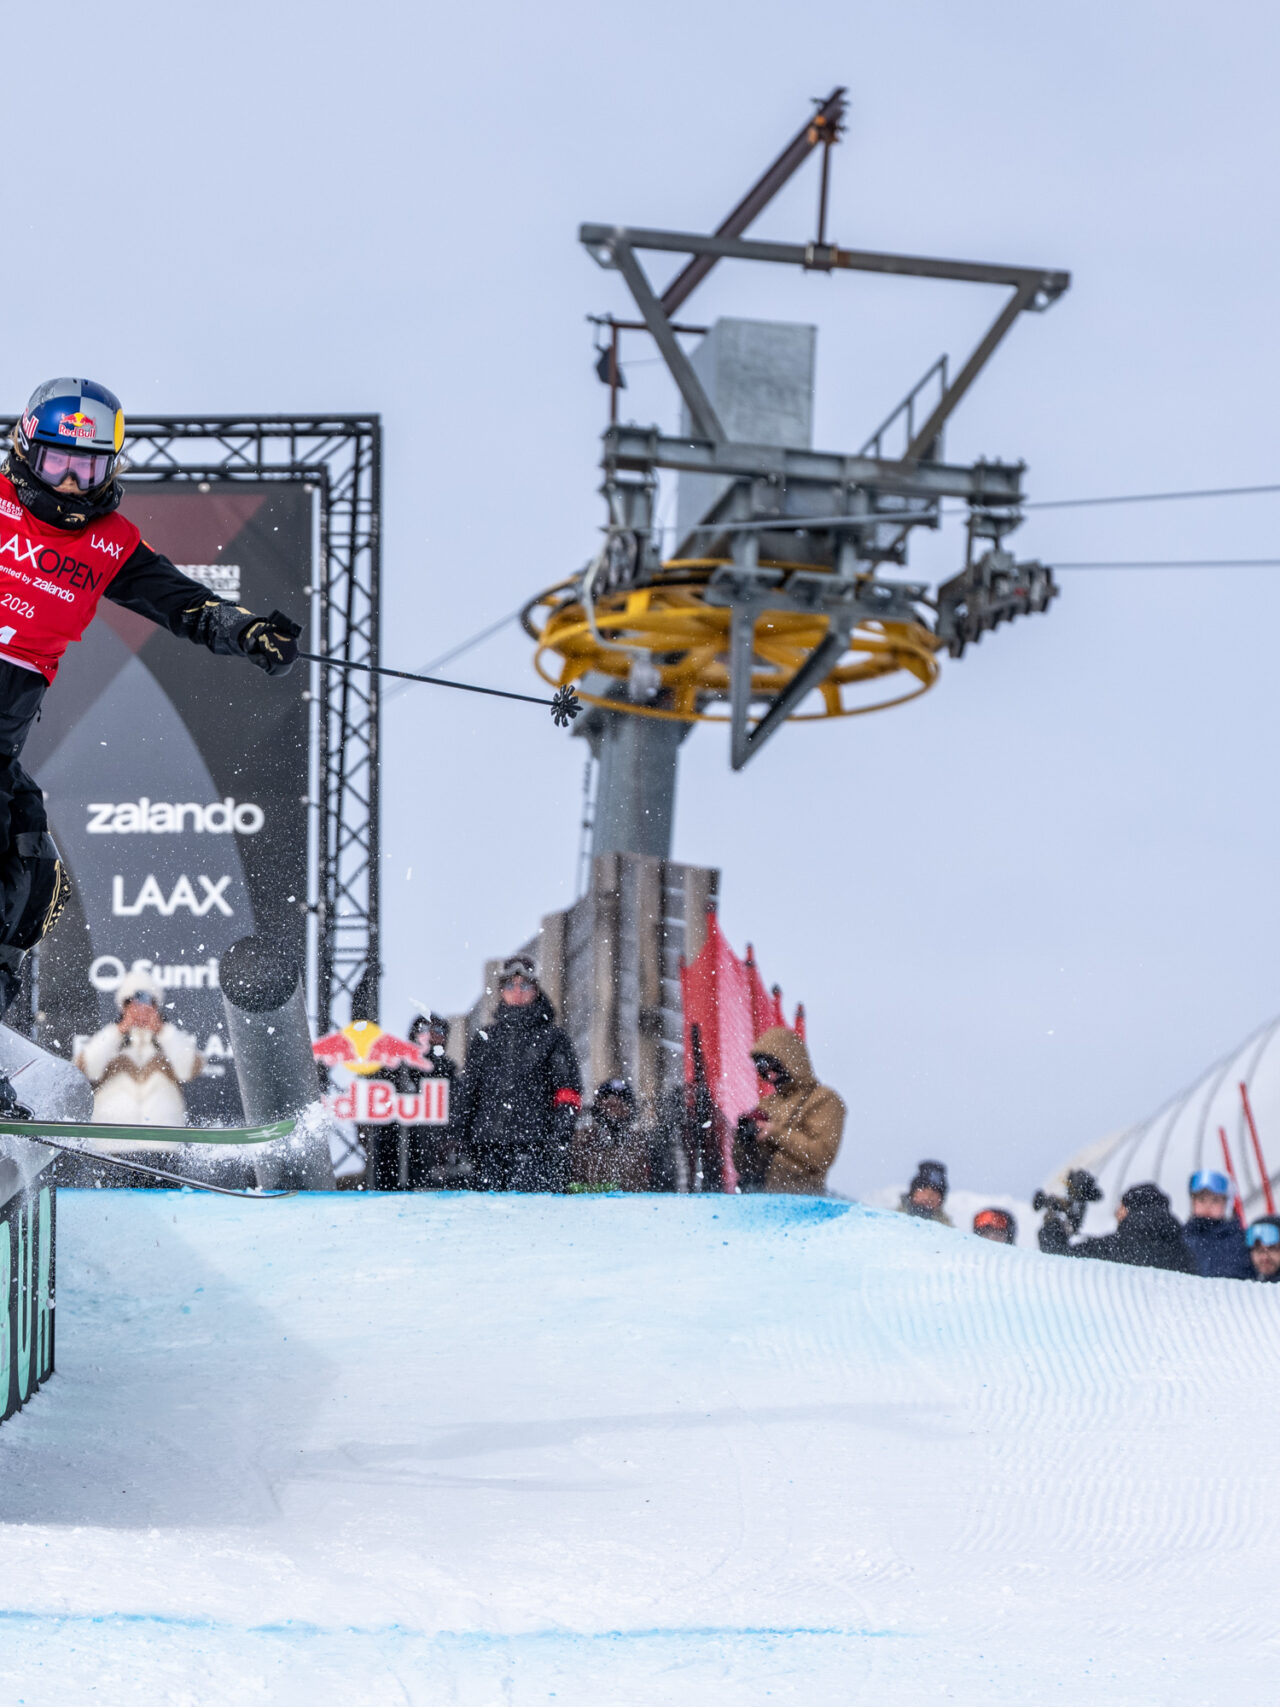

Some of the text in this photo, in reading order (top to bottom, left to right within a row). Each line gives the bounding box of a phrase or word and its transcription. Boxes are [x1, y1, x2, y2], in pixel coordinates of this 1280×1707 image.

[58, 424, 96, 438] Red Bull
[90, 534, 123, 559] LAAX
[21, 573, 32, 584] by
[32, 577, 75, 602] zalando
[0, 593, 36, 619] 2026
[86, 797, 265, 834] zalando
[112, 875, 233, 917] LAAX
[132, 957, 220, 990] Sunri
[367, 1083, 445, 1119] Bull
